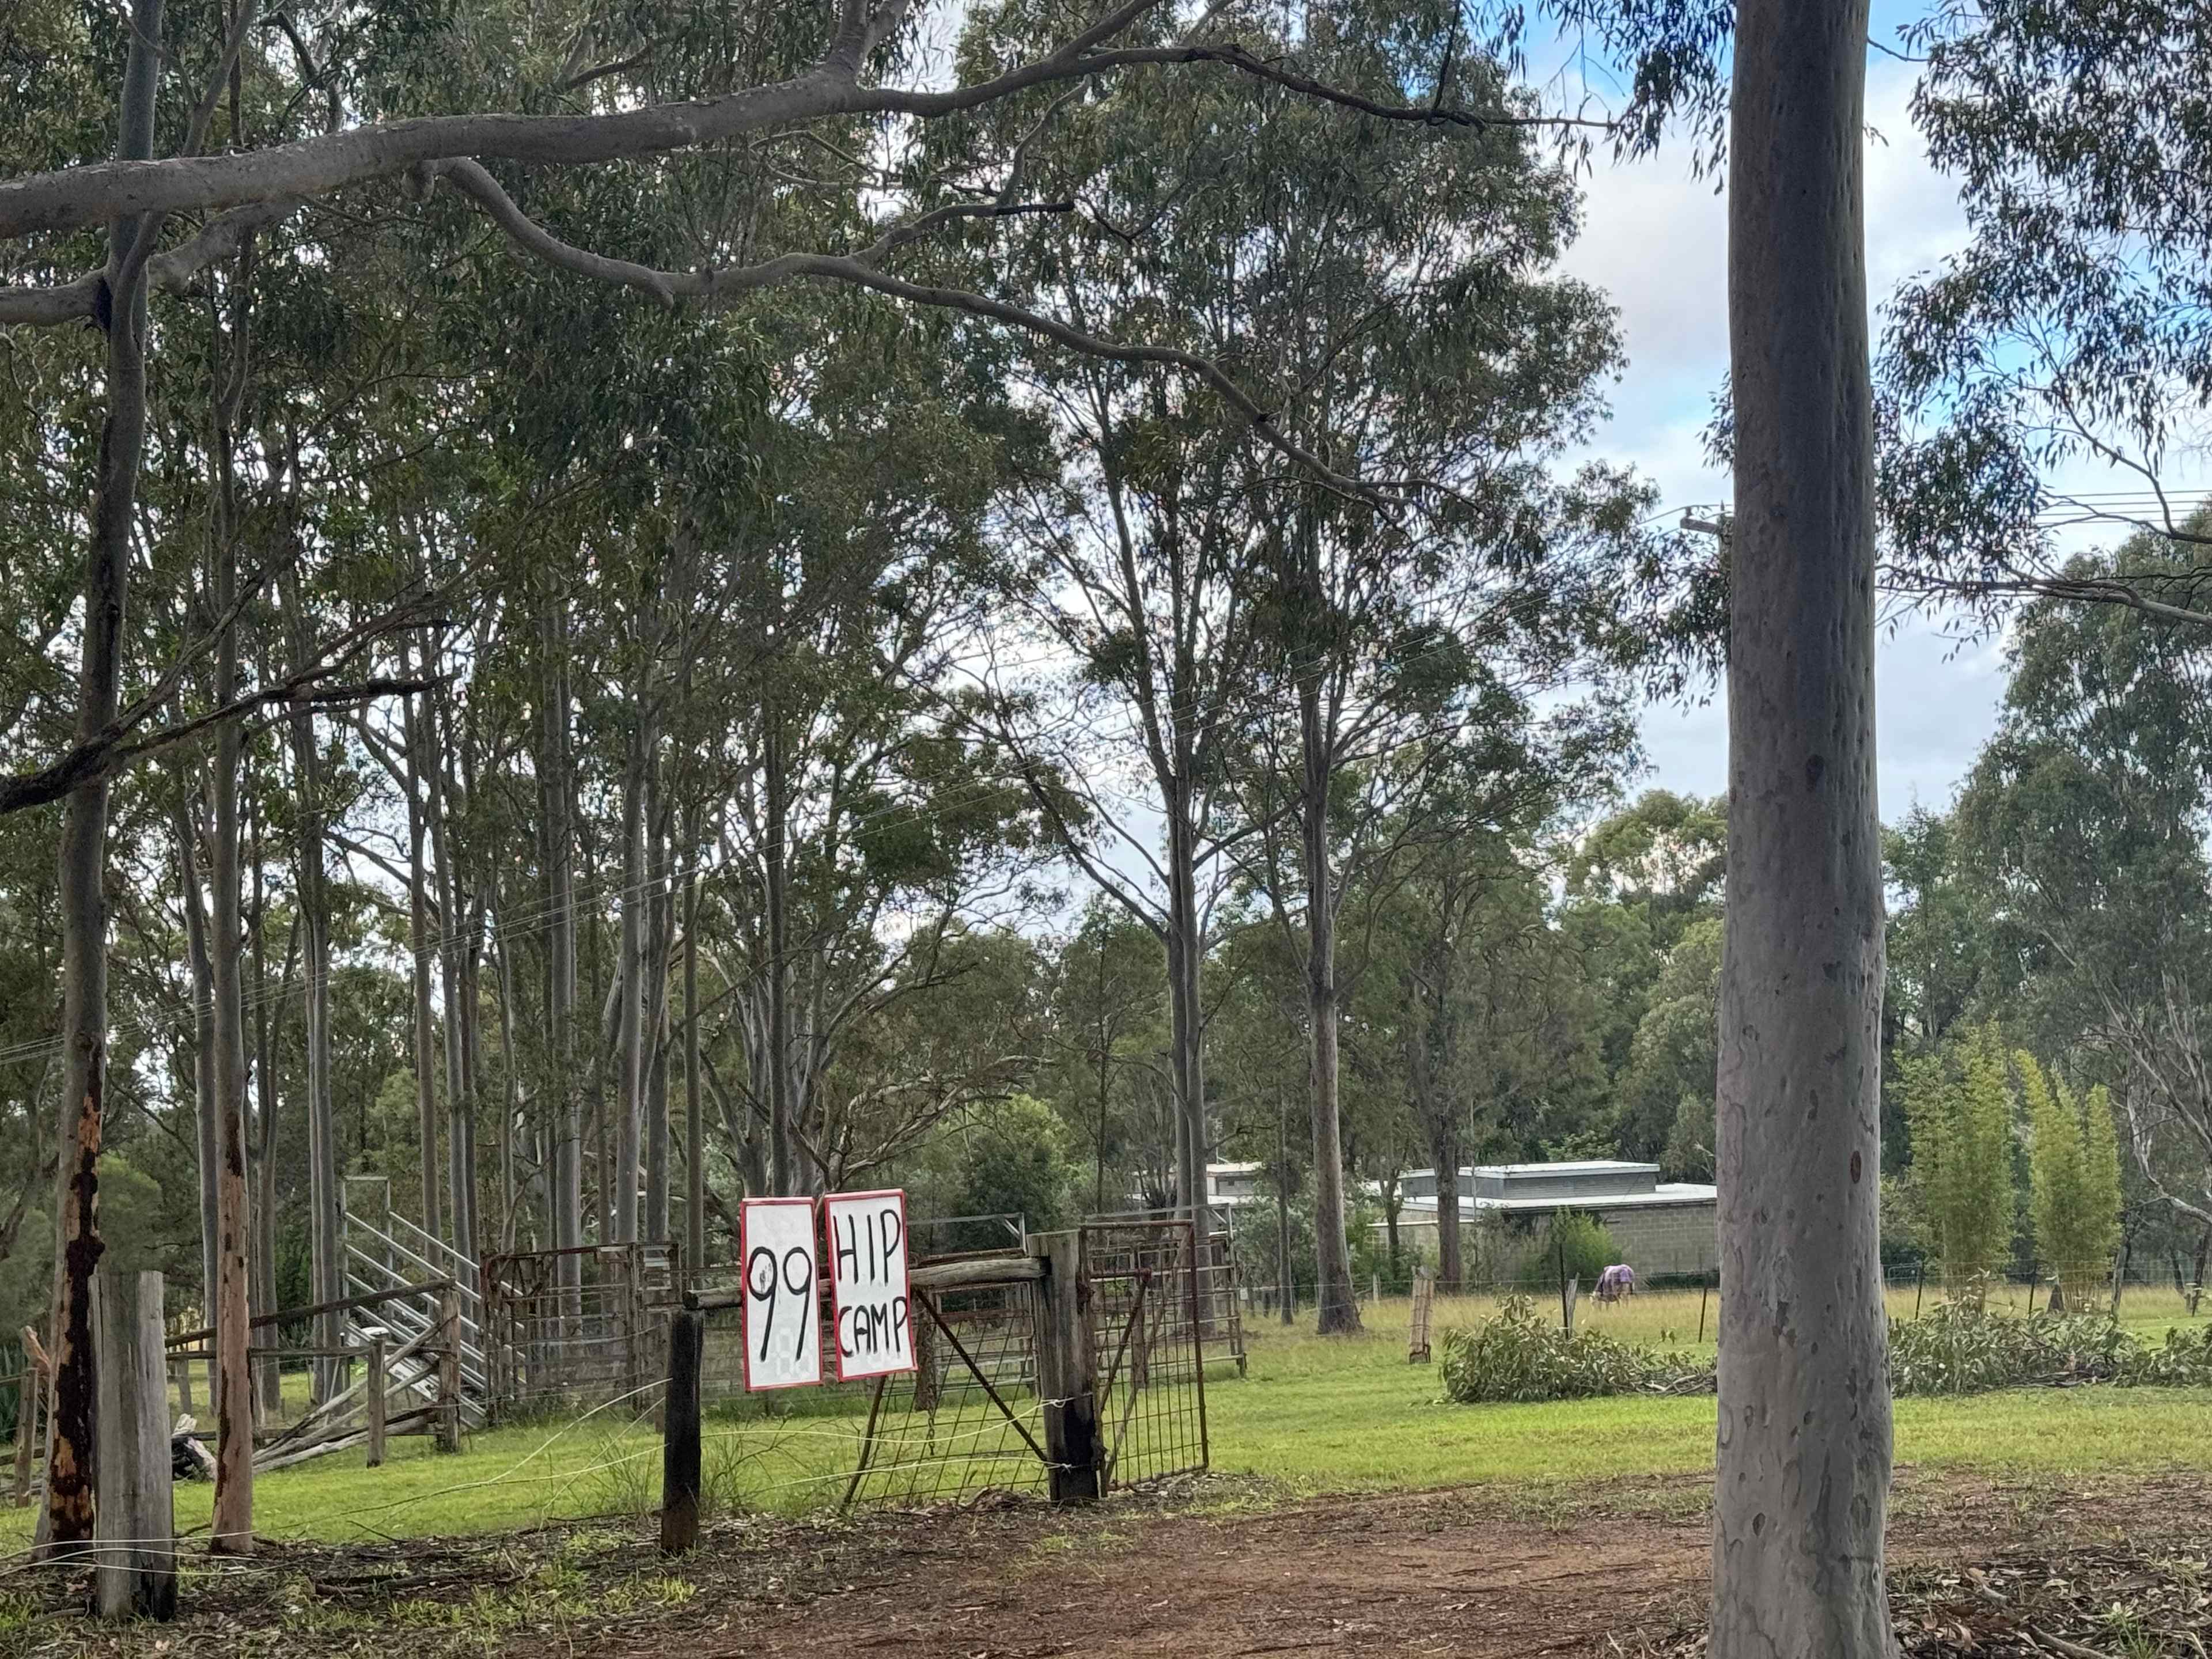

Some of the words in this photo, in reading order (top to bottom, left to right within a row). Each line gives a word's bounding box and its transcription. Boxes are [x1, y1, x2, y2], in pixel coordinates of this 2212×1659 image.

[834, 1209, 901, 1286] HIP
[748, 1246, 812, 1362] 99
[839, 1296, 908, 1359] CAMP
